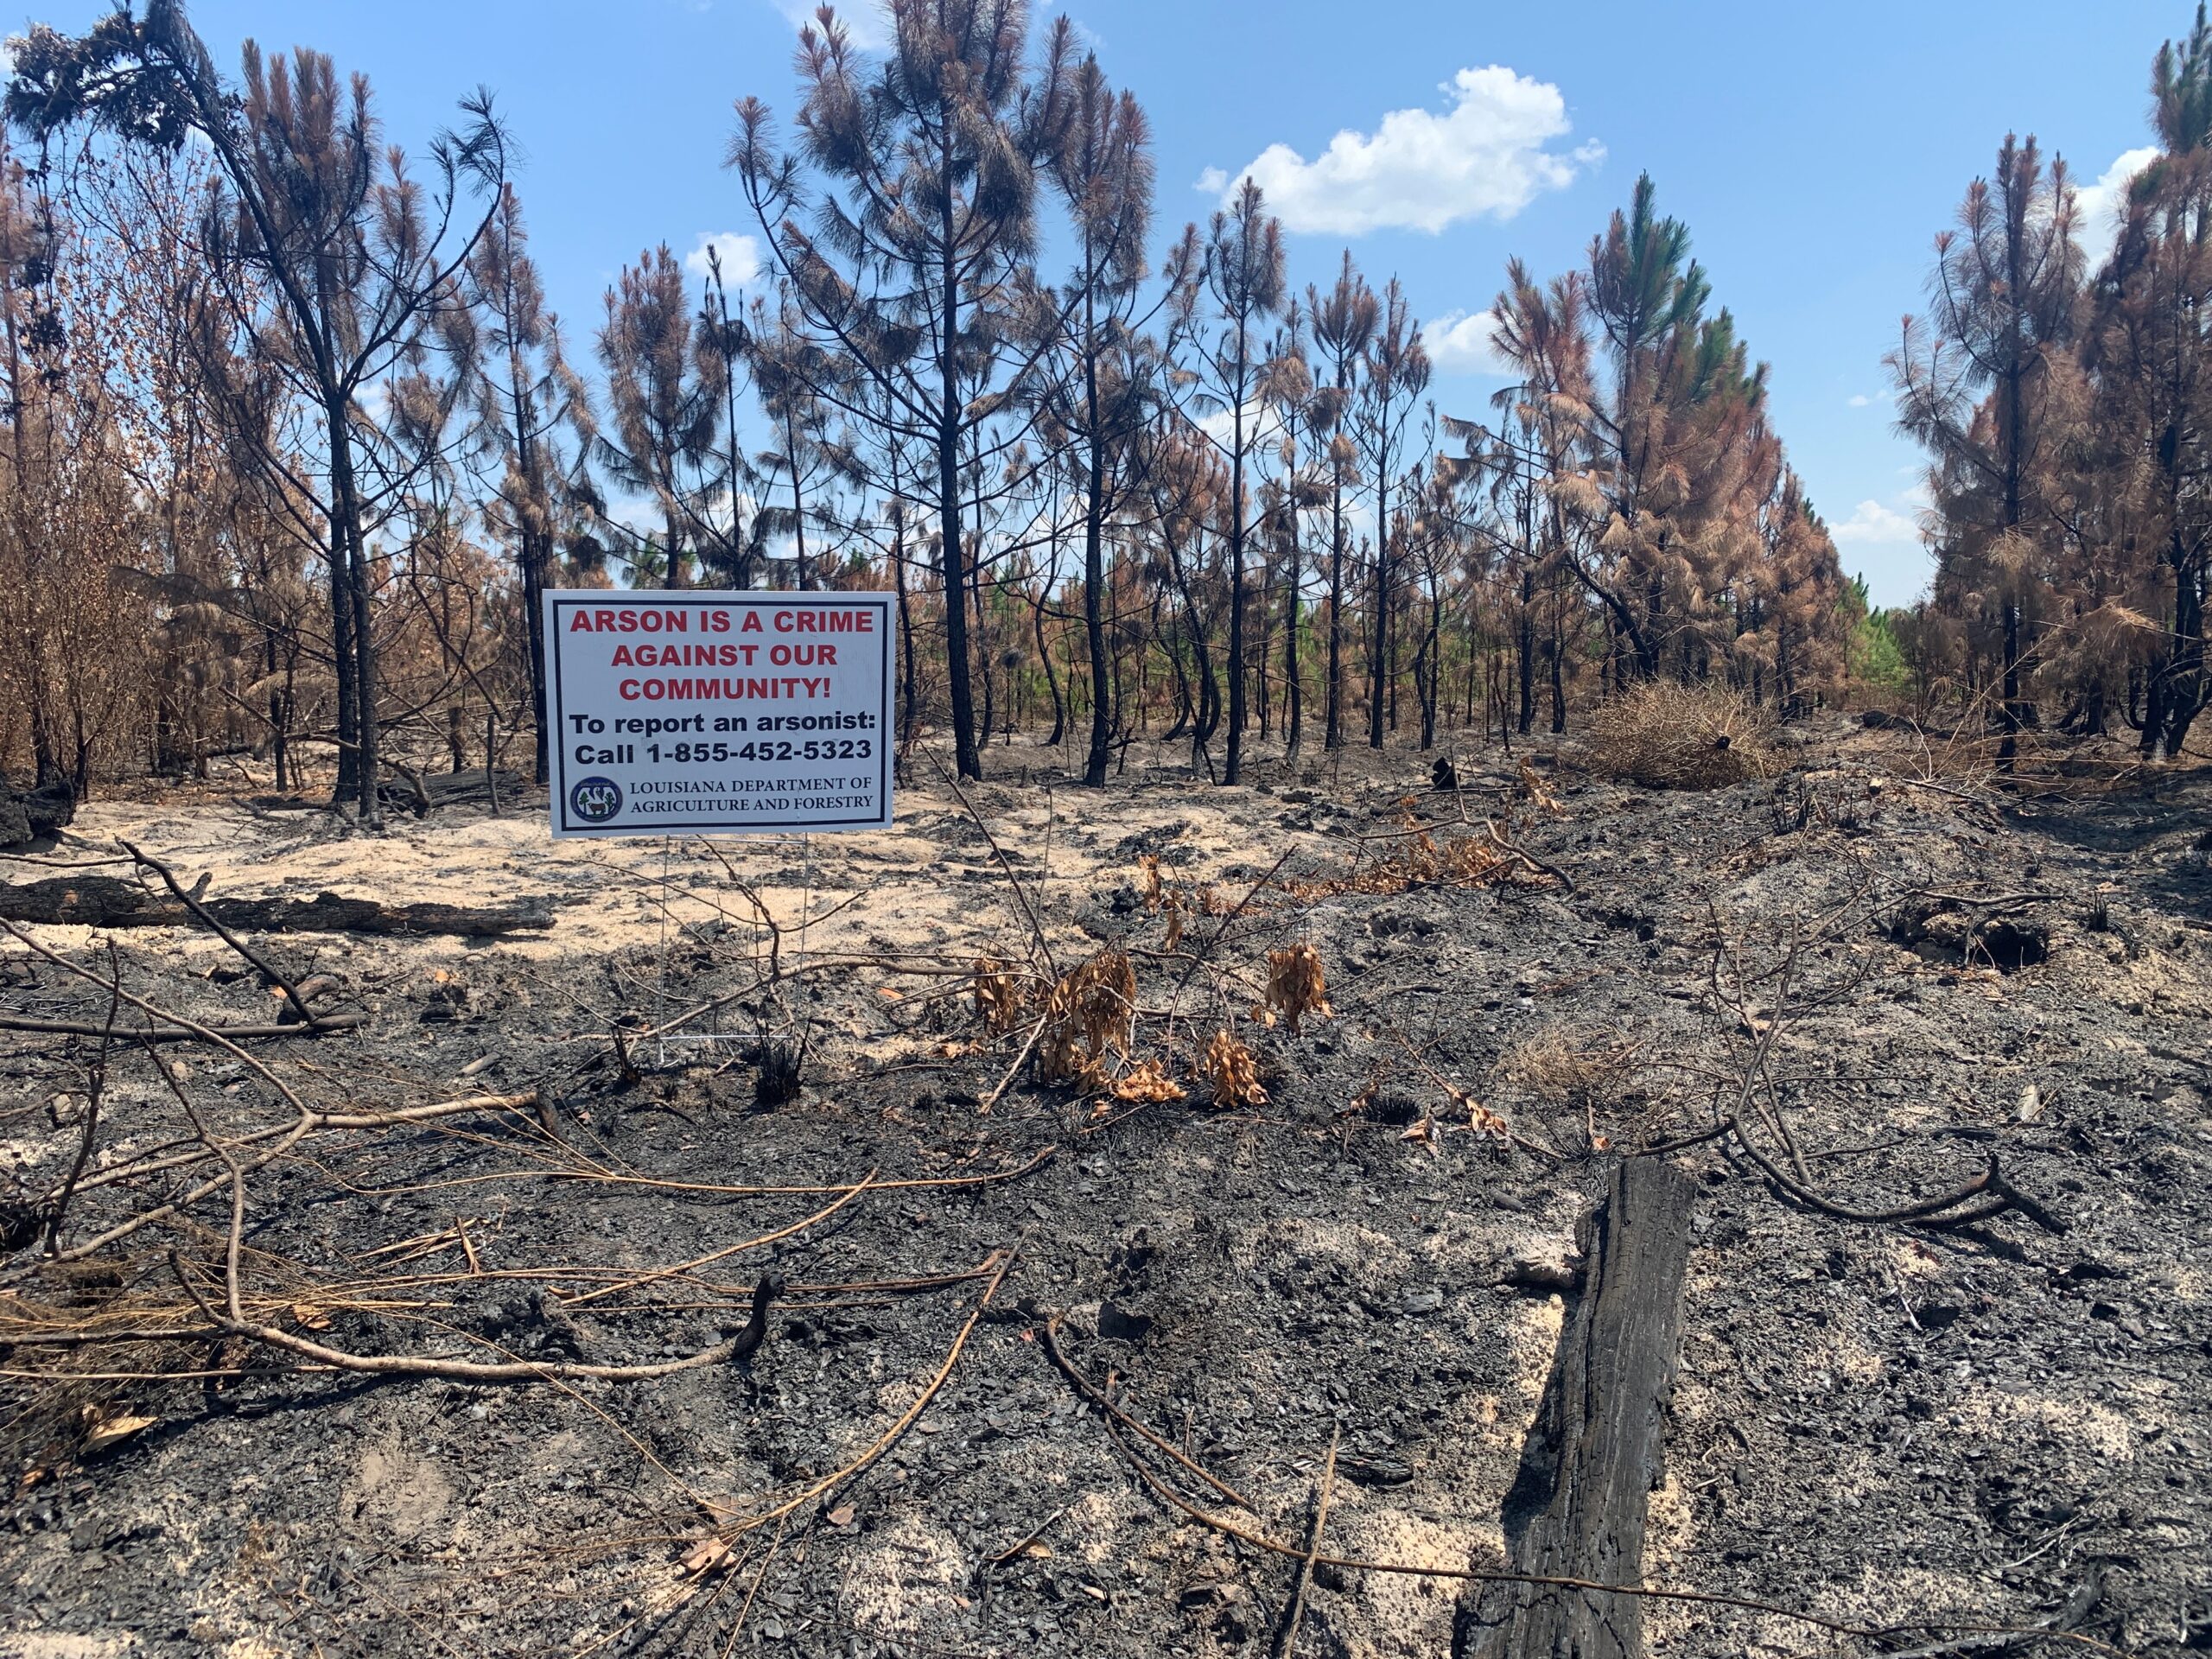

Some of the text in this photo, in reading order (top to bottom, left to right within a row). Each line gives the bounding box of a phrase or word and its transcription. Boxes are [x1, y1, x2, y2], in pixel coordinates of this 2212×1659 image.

[570, 610, 874, 633] ARSON IS A CRIME
[611, 645, 838, 667] AGAINST OUR
[619, 677, 831, 702] COMMUNITY!
[569, 710, 876, 738] To report an arsonist:
[575, 740, 872, 766] Call 1-855-452-5323
[630, 779, 728, 795] LOUISIANA
[731, 778, 846, 792] DEPARTMENT
[850, 777, 872, 790] OF
[631, 795, 874, 814] AGRICULTURE AND FORESTRY
